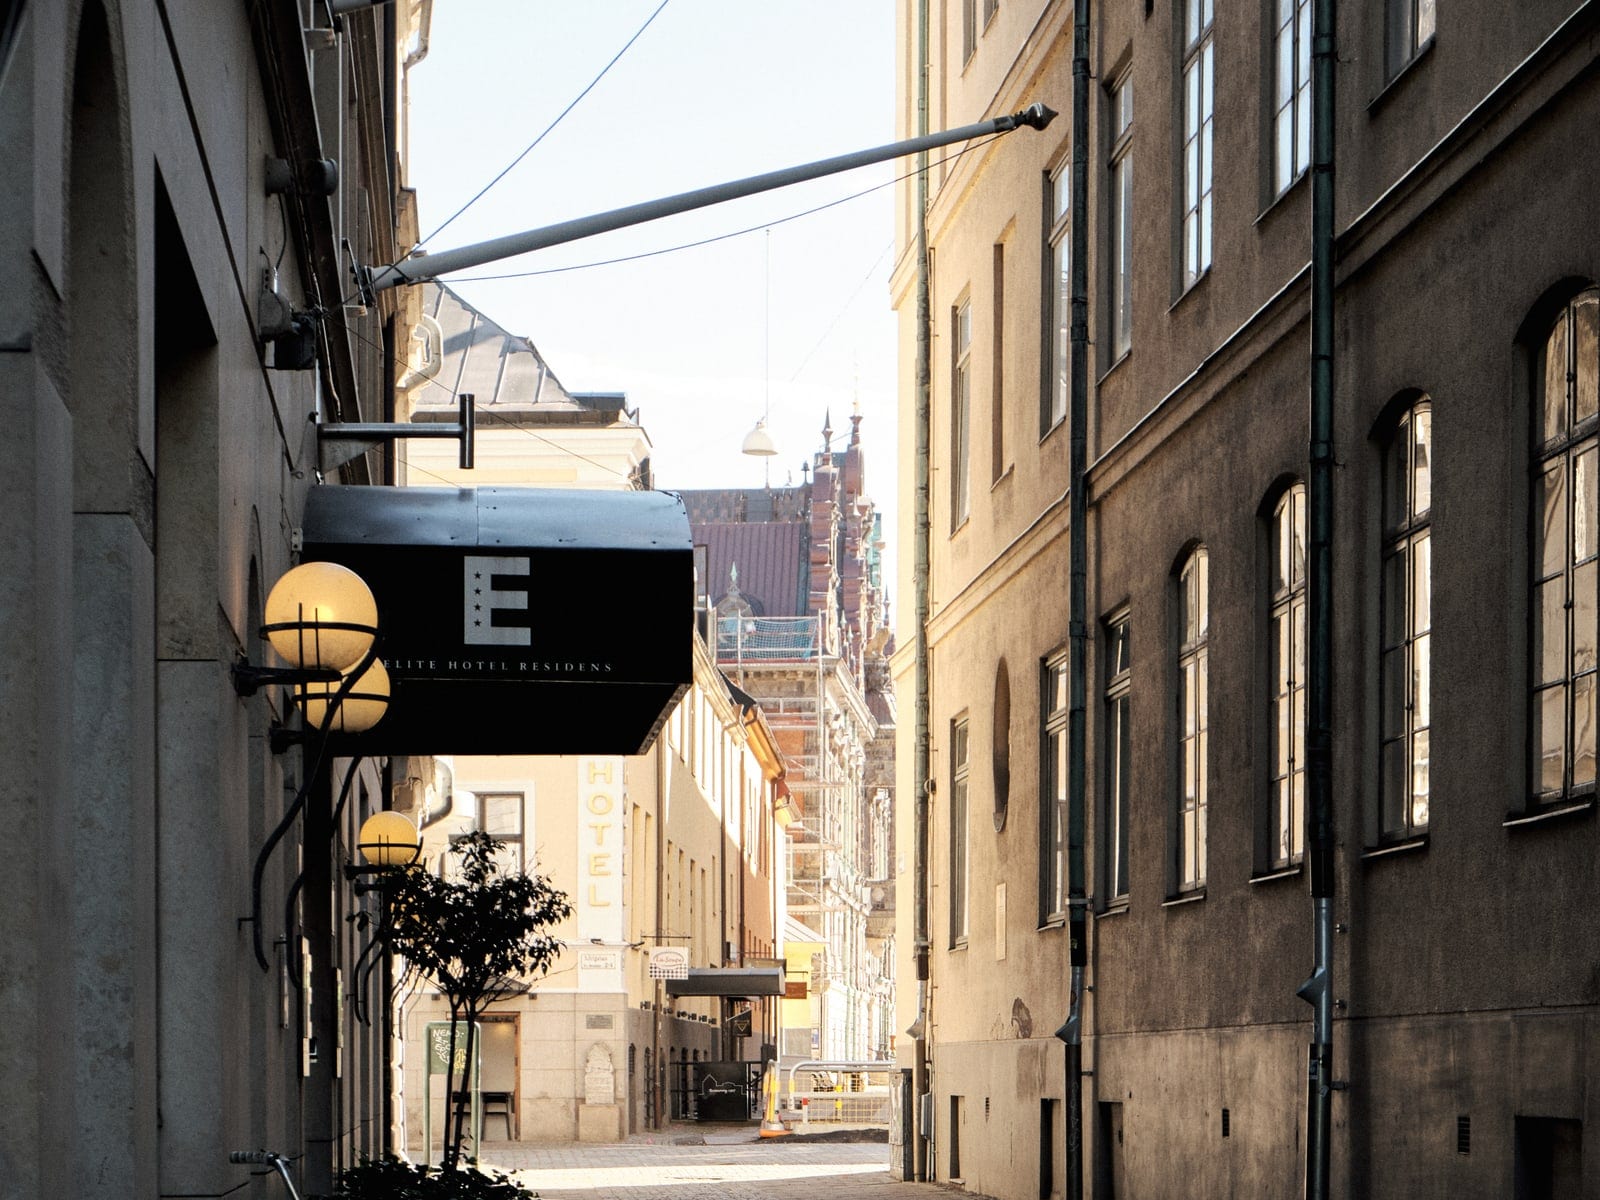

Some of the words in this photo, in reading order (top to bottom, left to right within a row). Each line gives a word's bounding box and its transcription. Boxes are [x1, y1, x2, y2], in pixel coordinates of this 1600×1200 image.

[464, 556, 531, 646] E
[383, 659, 437, 670] ELITE
[448, 660, 508, 671] HOTEL
[519, 662, 613, 672] RESIDENS
[588, 761, 614, 907] HOTEL
